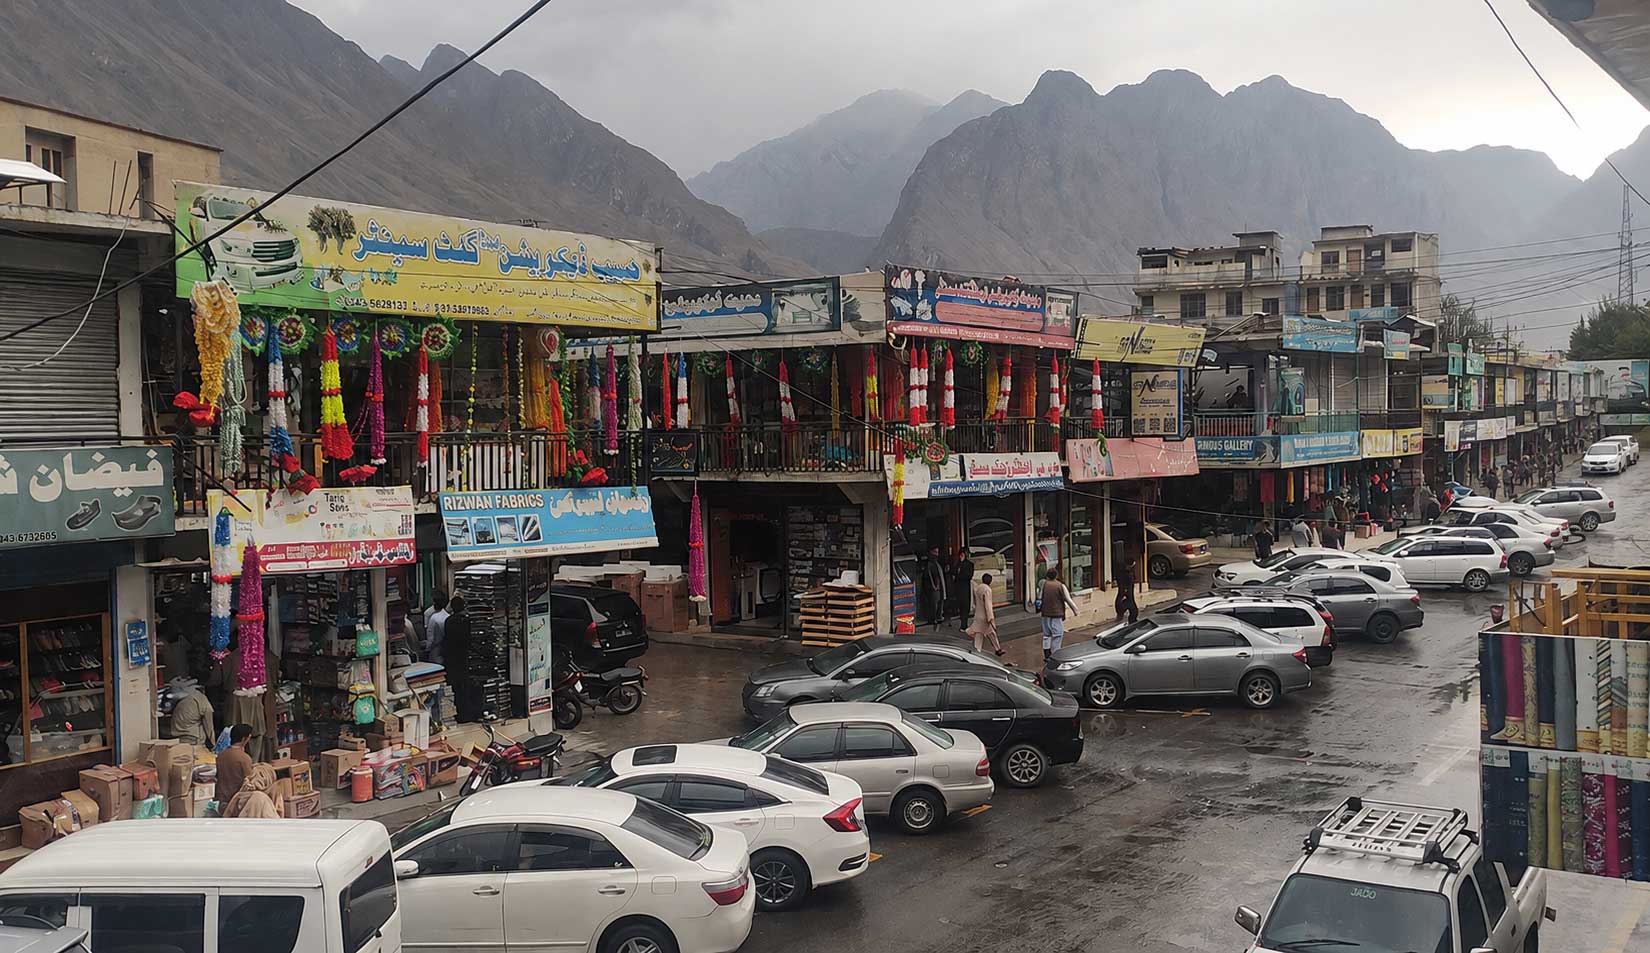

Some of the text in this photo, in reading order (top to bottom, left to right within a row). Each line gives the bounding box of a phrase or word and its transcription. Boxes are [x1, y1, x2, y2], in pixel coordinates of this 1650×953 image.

[29, 449, 164, 503] فیضان
[323, 492, 345, 503] Tariq
[443, 493, 544, 511] RIZWAN FABRICS
[329, 503, 350, 513] Sons
[1350, 887, 1377, 899] JADO
